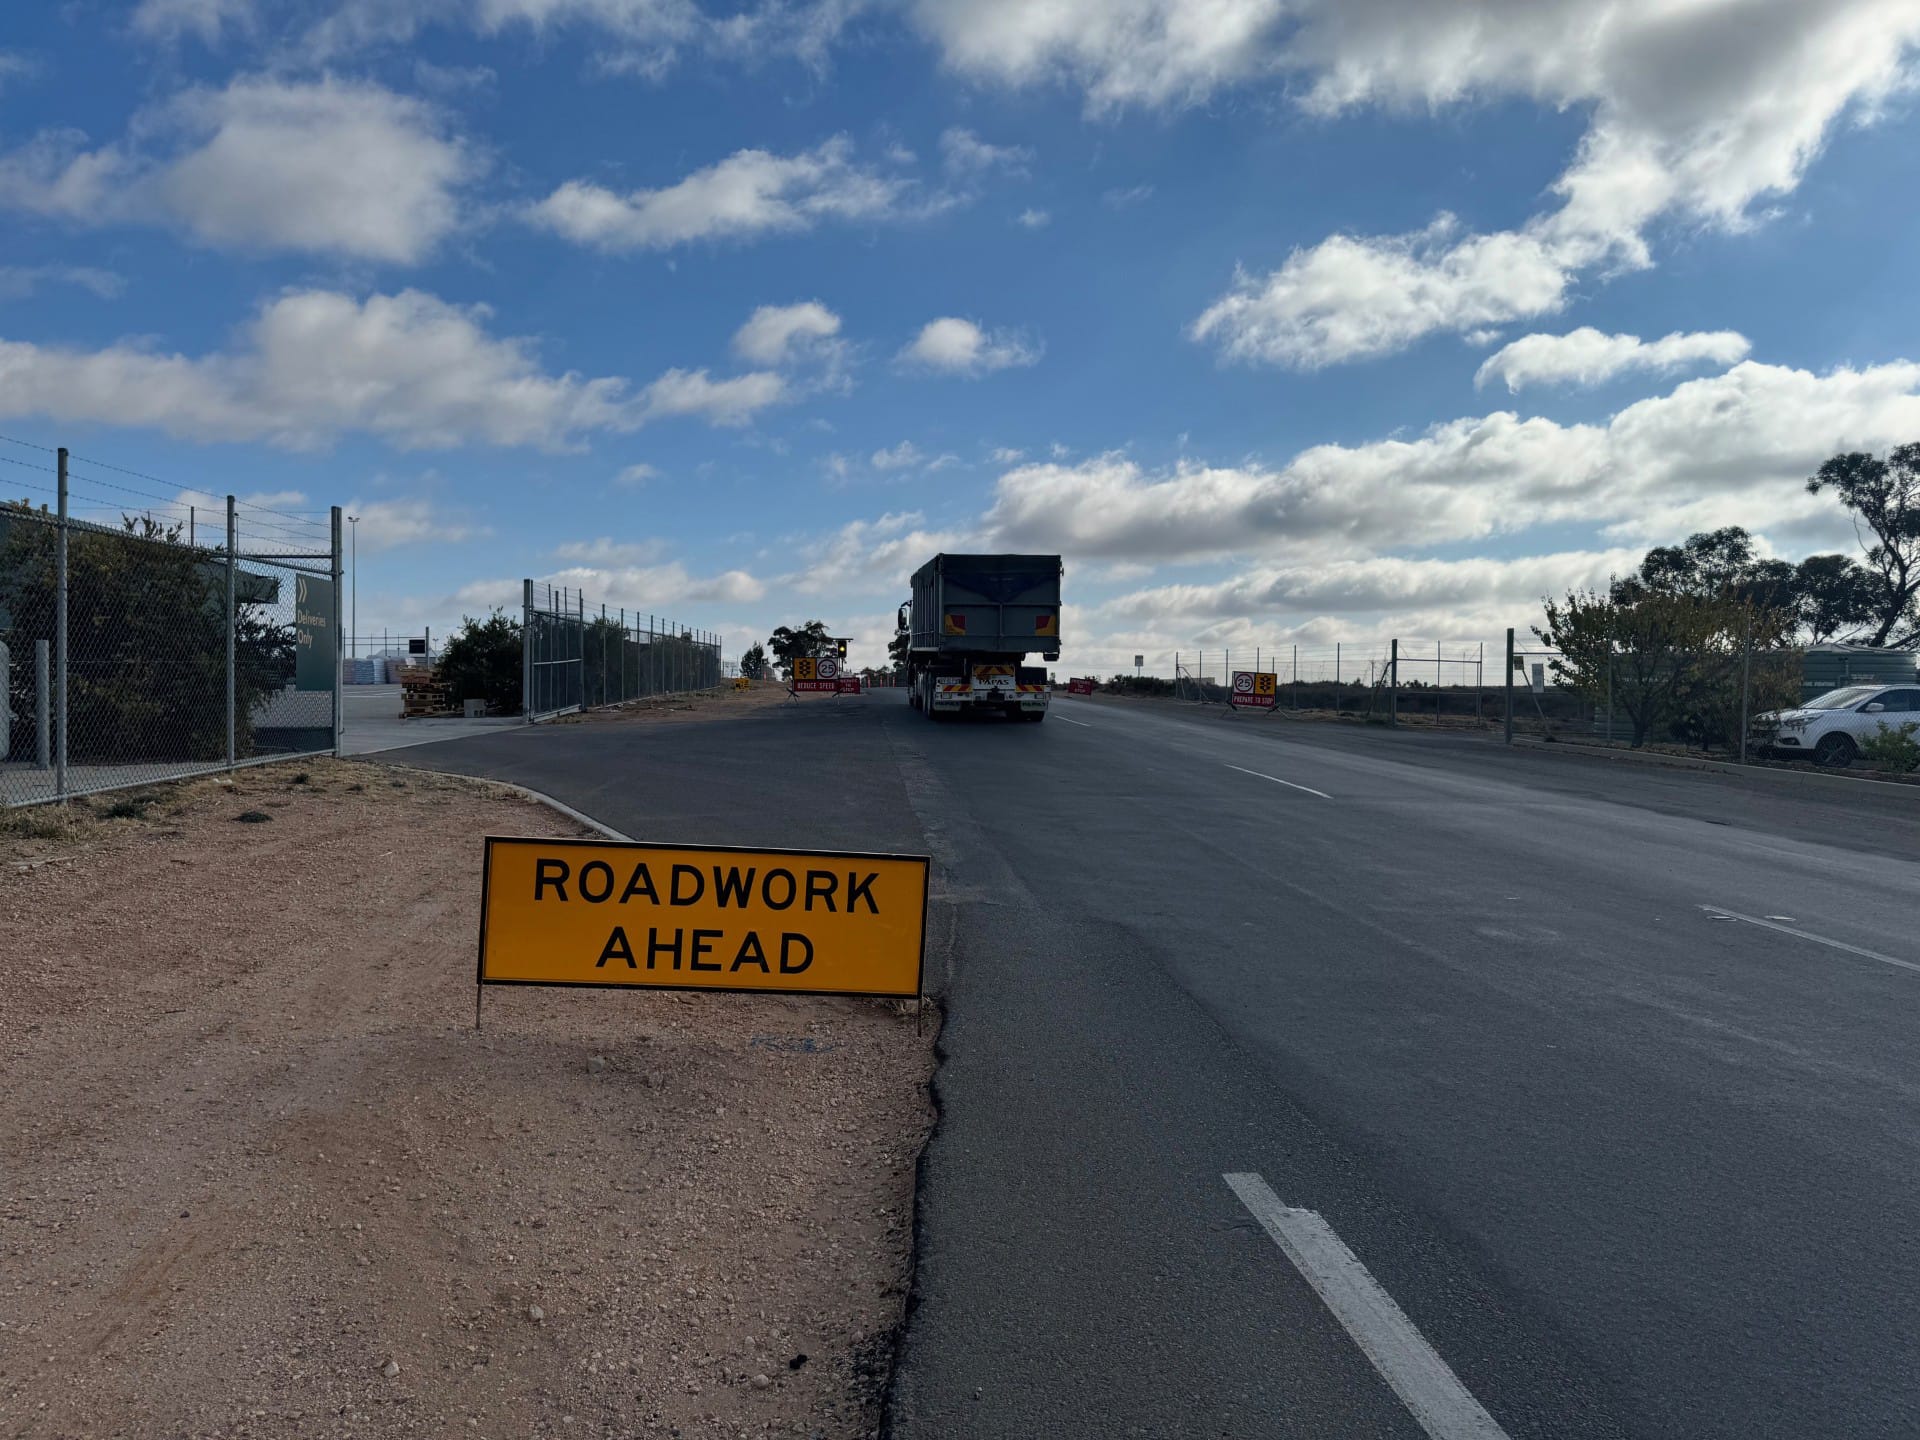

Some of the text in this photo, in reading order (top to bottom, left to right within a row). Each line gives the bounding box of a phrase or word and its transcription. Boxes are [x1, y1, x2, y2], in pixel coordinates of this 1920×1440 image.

[297, 610, 326, 627] Deliveries
[297, 629, 312, 648] Only
[821, 665, 833, 673] 25
[1238, 679, 1250, 688] 25
[534, 858, 880, 914] ROADWORK
[595, 926, 814, 975] AHEAD
